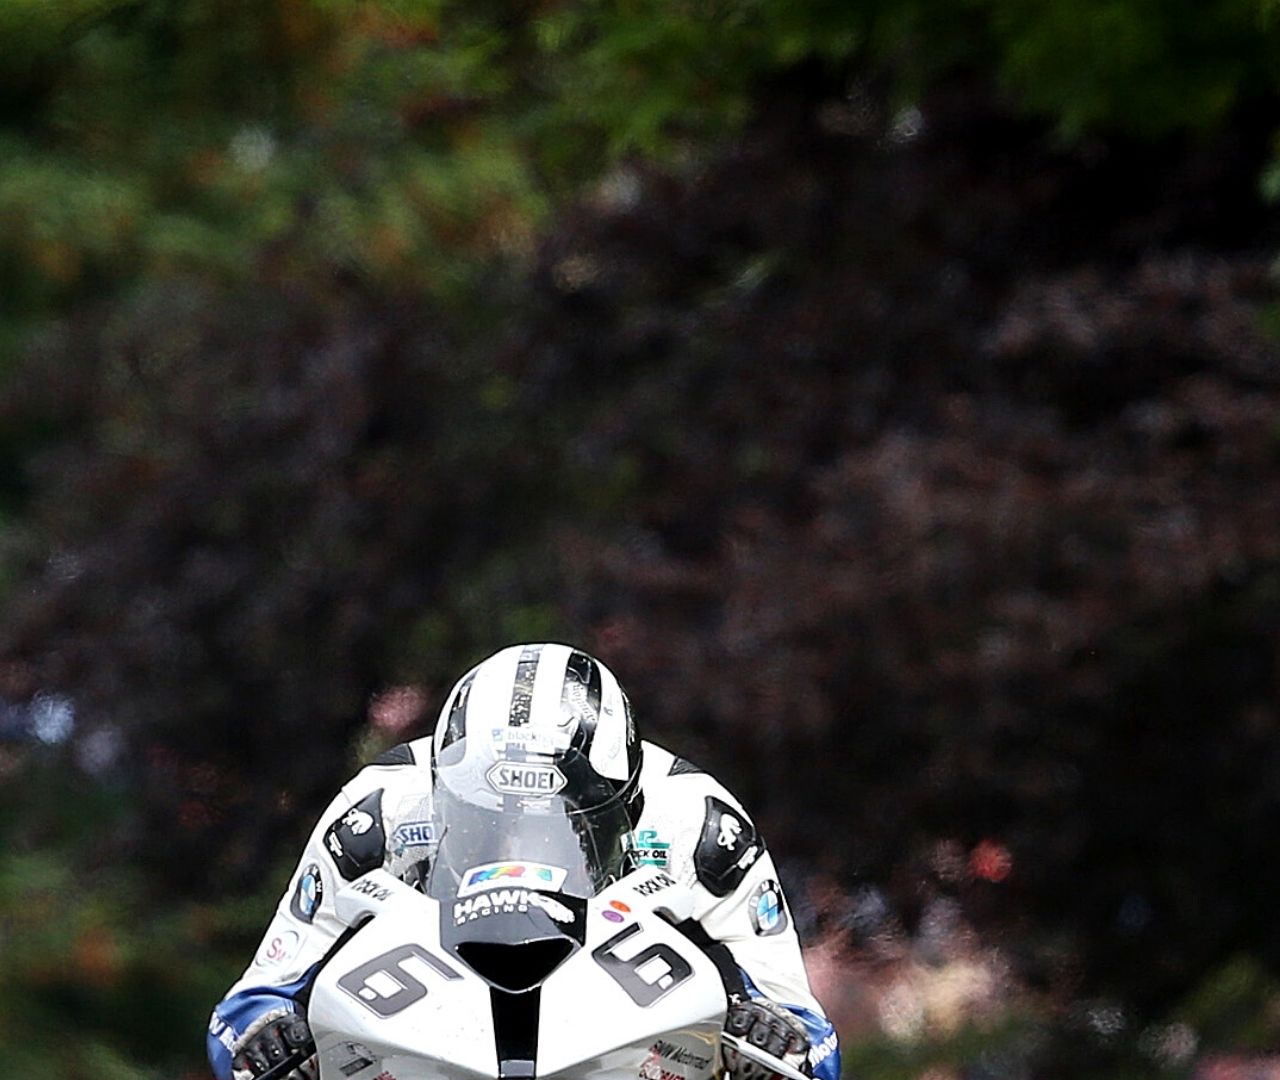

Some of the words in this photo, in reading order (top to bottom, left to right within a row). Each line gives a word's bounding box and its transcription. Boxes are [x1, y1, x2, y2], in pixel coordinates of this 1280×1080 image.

[499, 768, 555, 790] SHOEI
[336, 943, 465, 1019] 6
[591, 921, 695, 1008] 6
